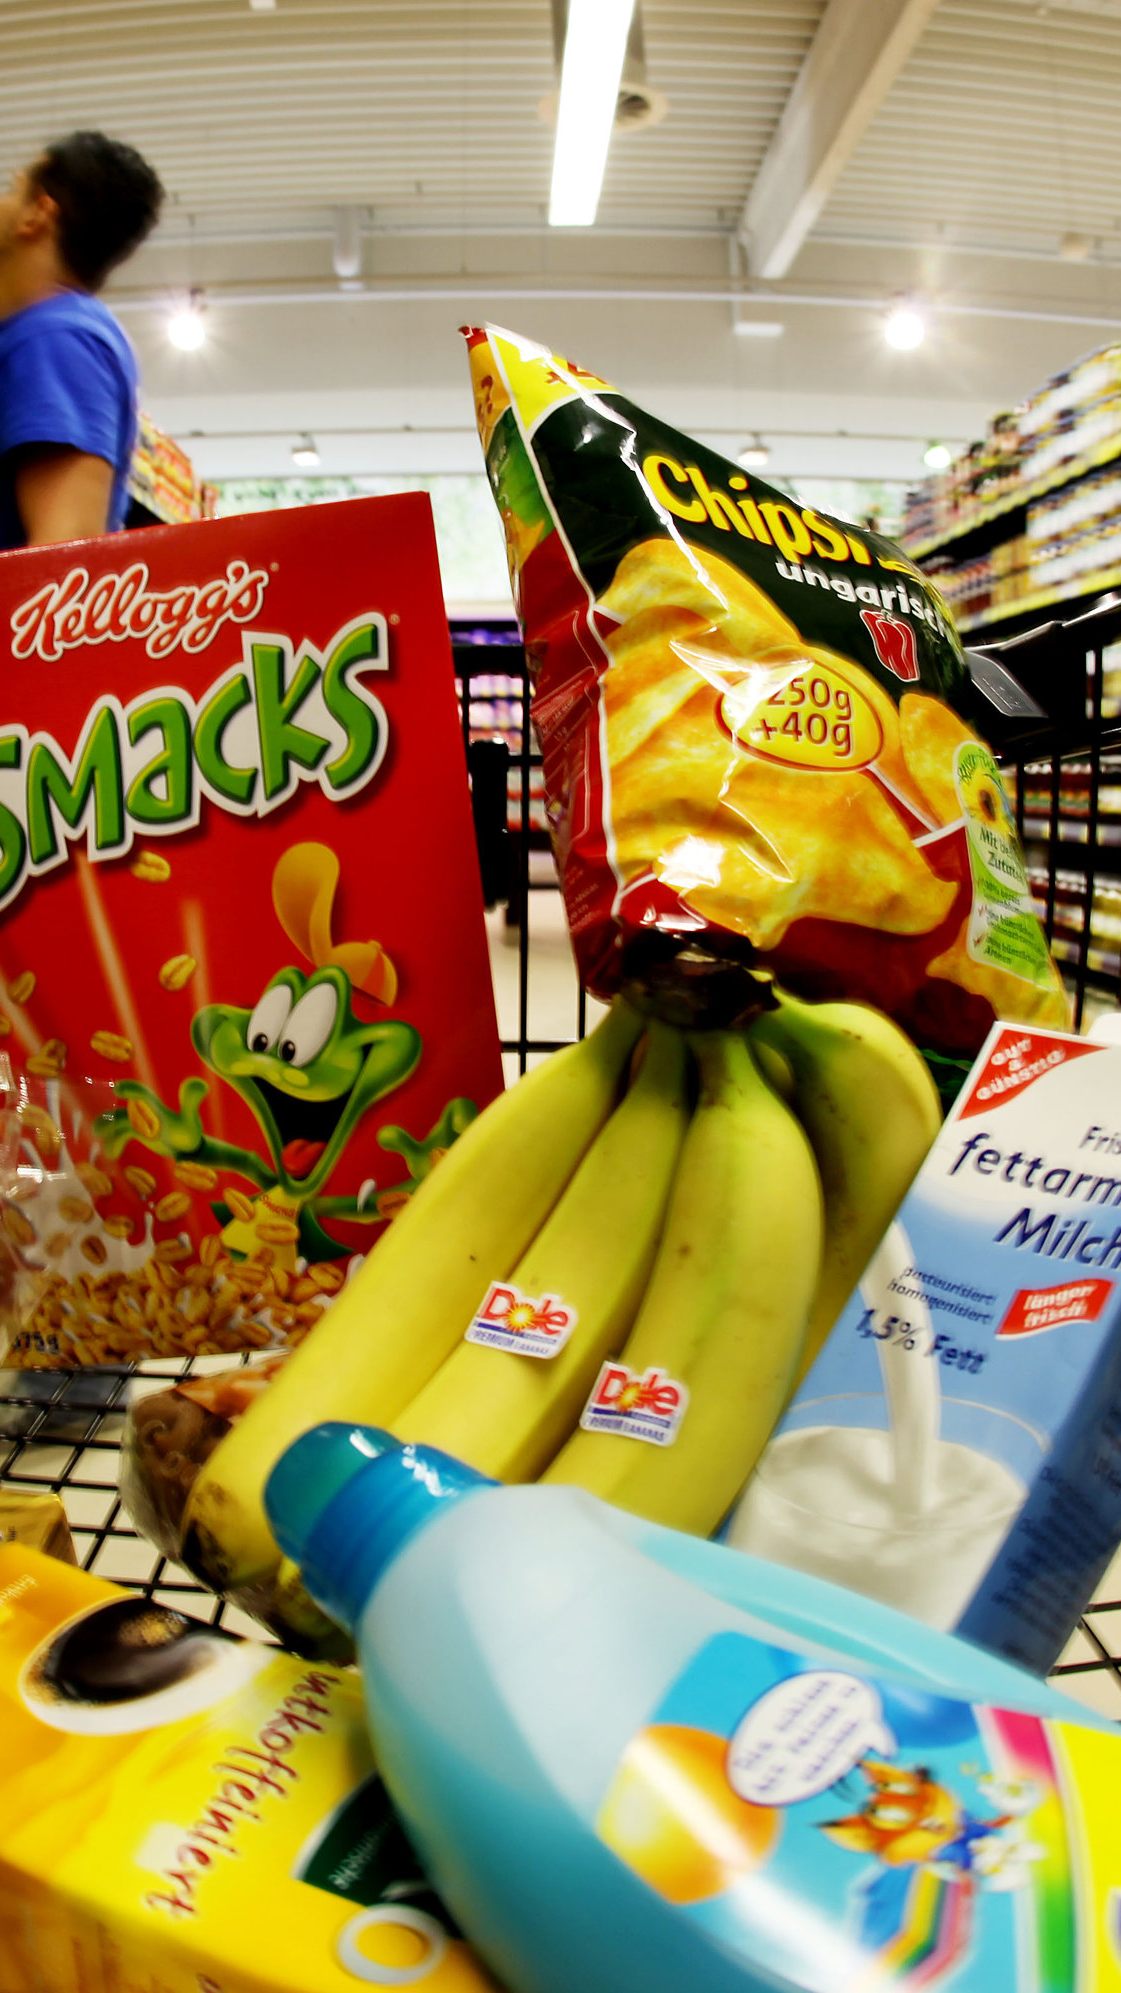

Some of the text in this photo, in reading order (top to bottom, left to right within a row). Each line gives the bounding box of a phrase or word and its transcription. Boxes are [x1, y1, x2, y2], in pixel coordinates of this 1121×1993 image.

[10, 560, 270, 662] Kellogg's
[755, 711, 852, 757] +40g
[947, 1132, 1121, 1207] fettarm
[992, 1207, 1121, 1271] Milch
[480, 1287, 569, 1336] Dole
[856, 1308, 986, 1375] 1,5% Fett
[596, 1368, 680, 1416] Dole
[145, 1669, 343, 1916] ntkoffeiniert
